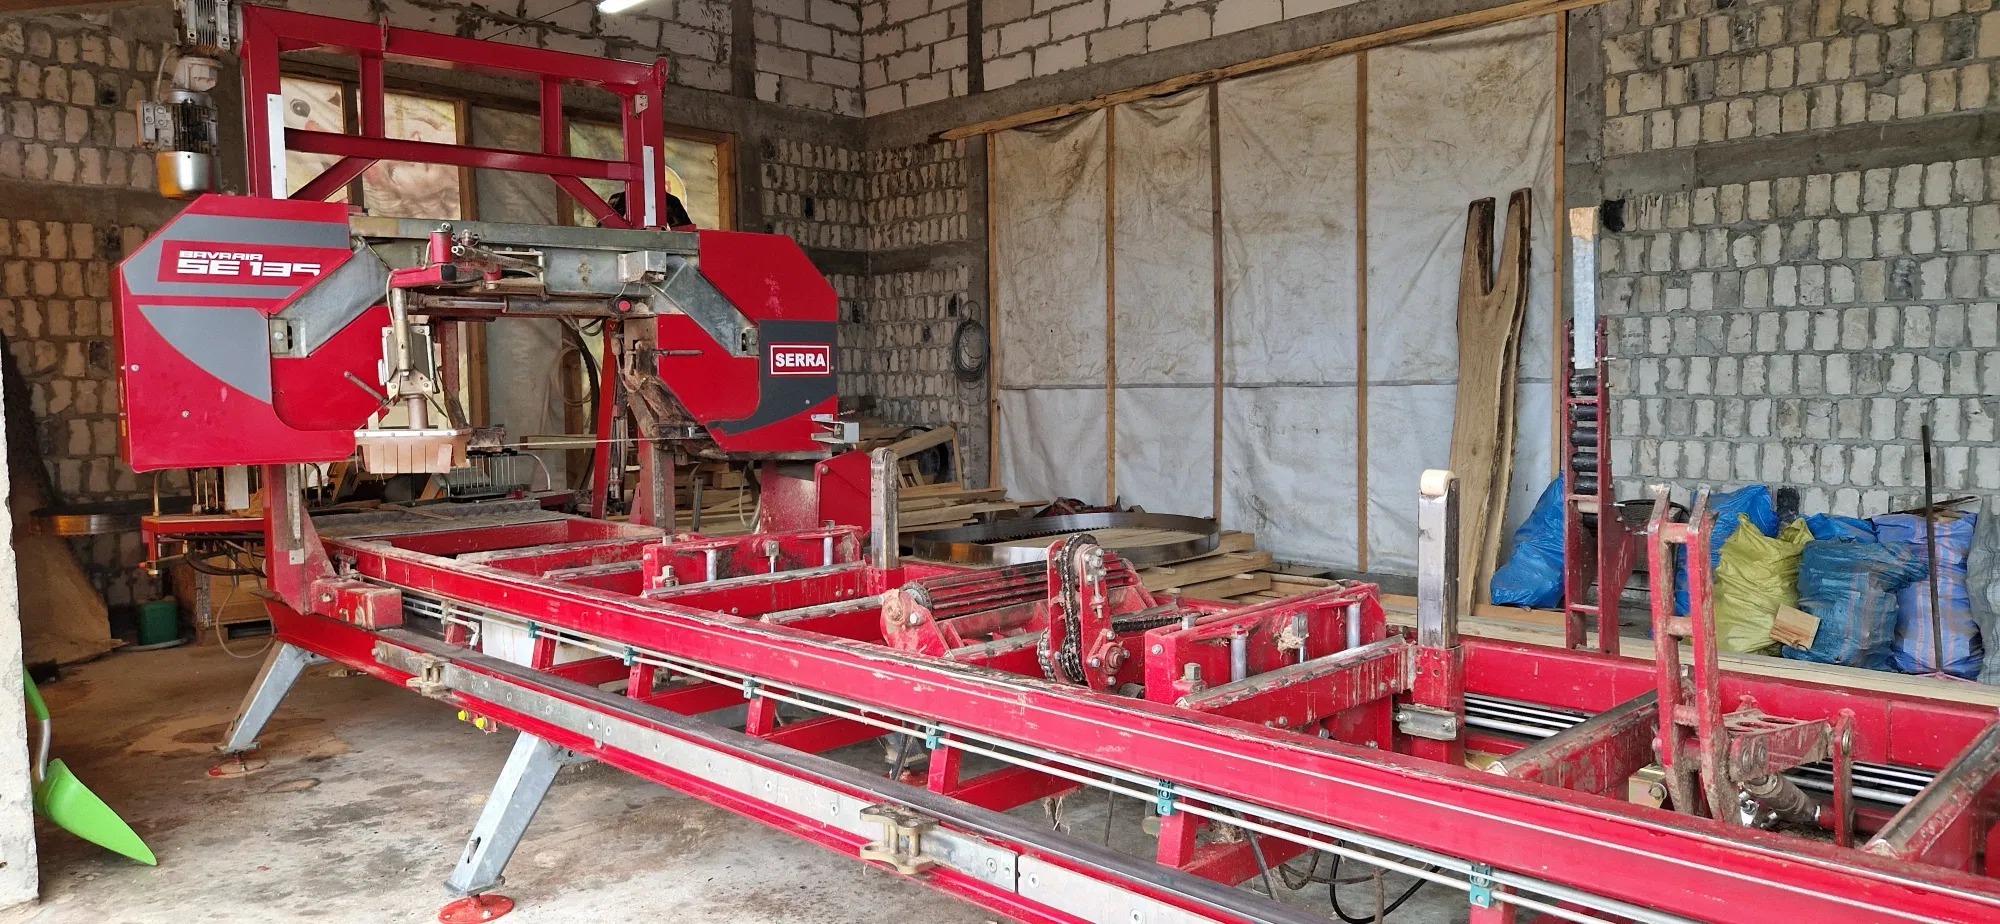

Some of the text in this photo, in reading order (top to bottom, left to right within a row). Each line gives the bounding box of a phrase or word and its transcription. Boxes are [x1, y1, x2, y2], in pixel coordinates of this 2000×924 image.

[179, 250, 263, 261] BAVARIA
[177, 258, 321, 277] SE 135
[775, 353, 826, 367] SERRA
